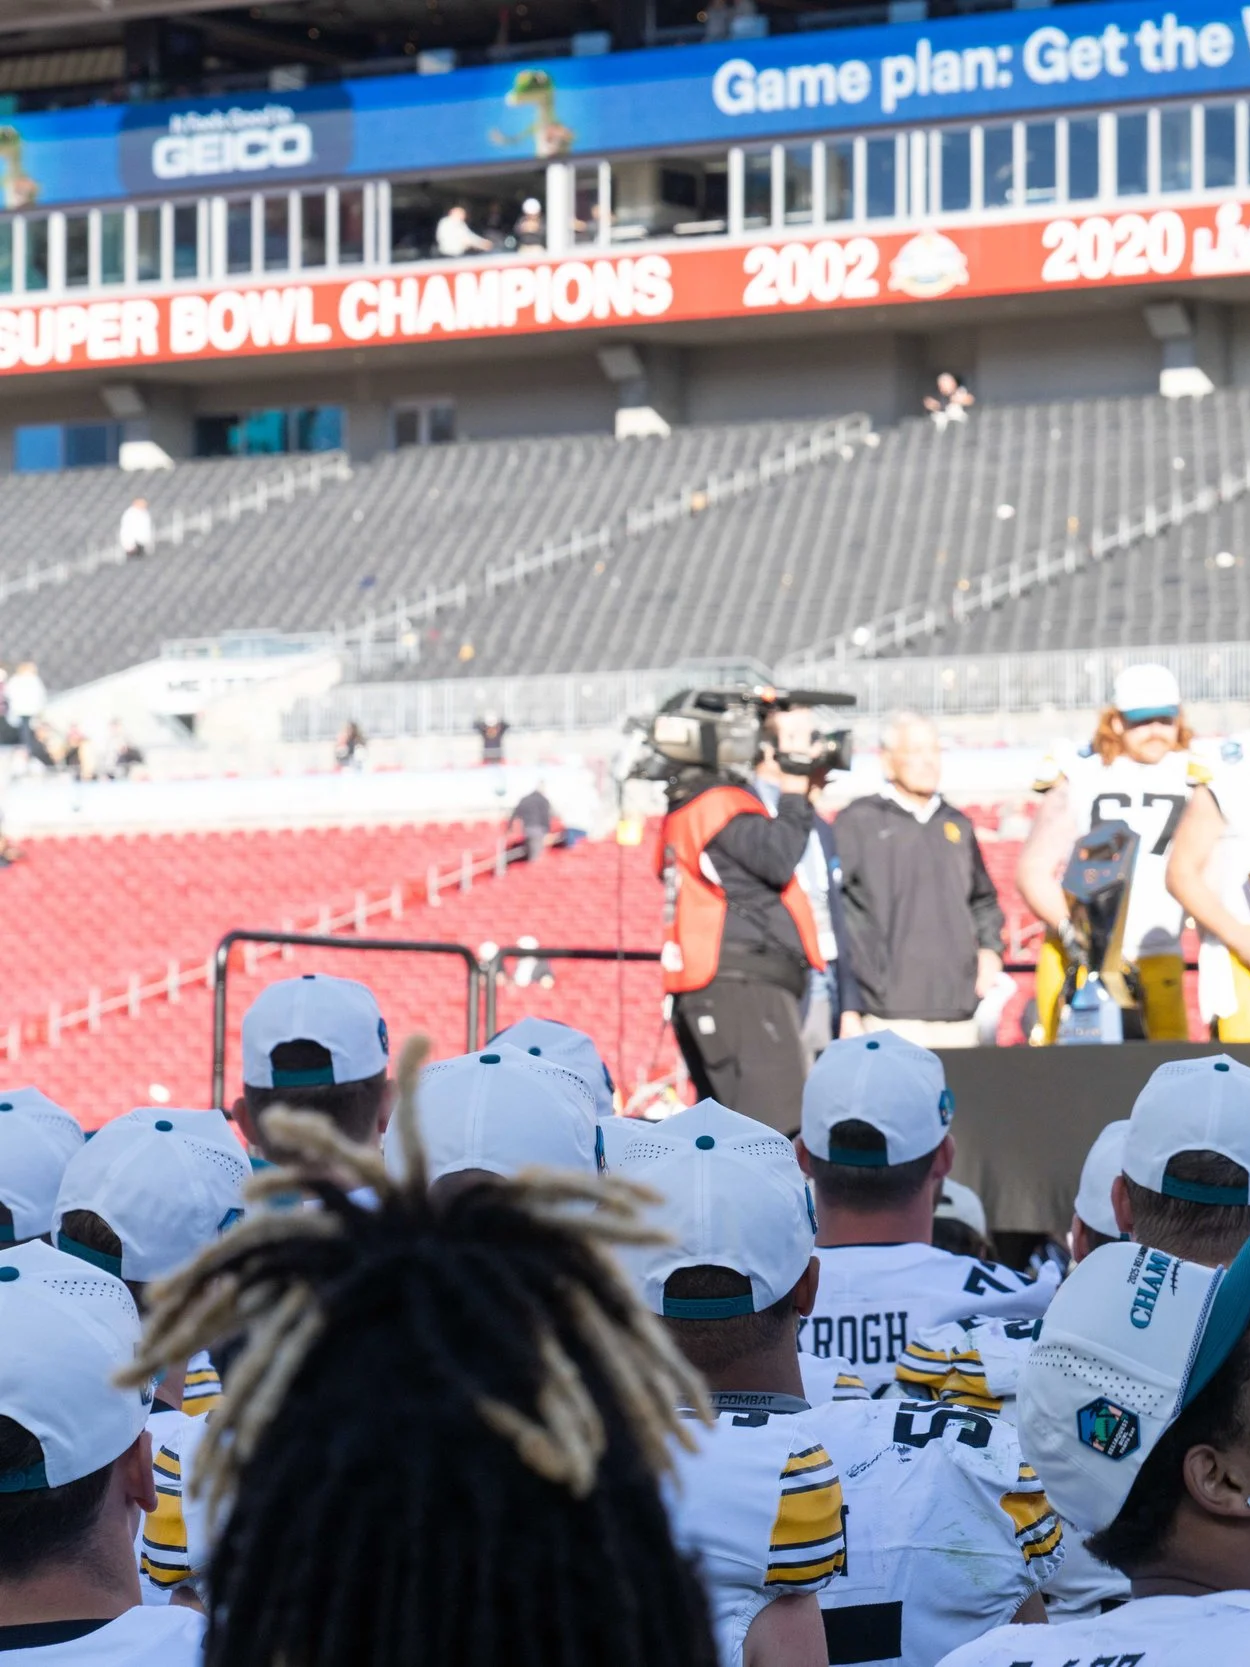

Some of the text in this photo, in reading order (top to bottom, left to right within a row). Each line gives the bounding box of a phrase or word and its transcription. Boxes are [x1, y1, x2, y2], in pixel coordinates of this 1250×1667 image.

[712, 58, 871, 116] Game
[880, 37, 1013, 114] plan:
[1023, 24, 1128, 85] Get
[1135, 12, 1234, 74] the
[152, 123, 313, 179] GEICO
[742, 236, 880, 307] 2002
[1041, 210, 1186, 282] 2020
[0, 254, 673, 370] SUPER BOWL CHAMPIONS
[718, 1394, 775, 1406] COMBAT
